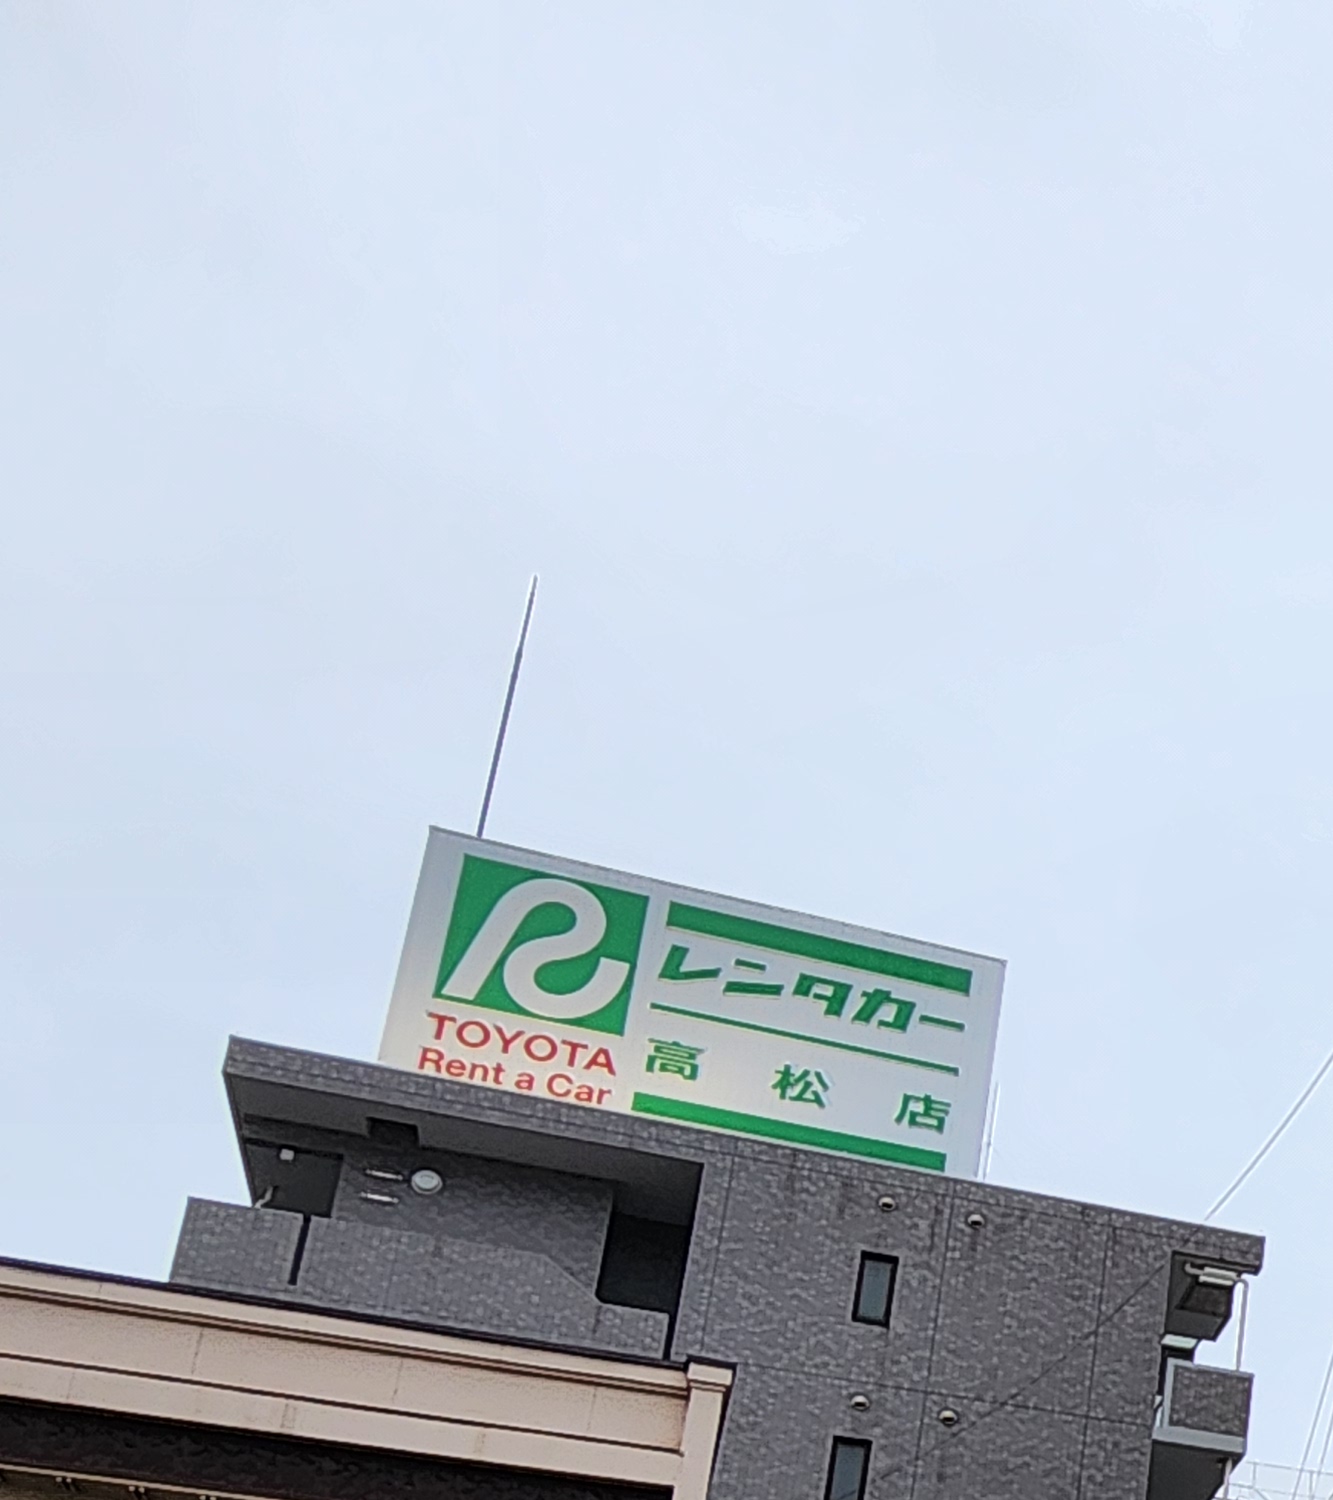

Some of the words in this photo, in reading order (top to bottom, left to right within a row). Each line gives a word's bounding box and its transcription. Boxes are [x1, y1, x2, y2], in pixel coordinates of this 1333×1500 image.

[658, 944, 966, 1033] レンタカー
[418, 1046, 505, 1085] Rent
[514, 1071, 535, 1091] a
[546, 1073, 612, 1105] Car
[426, 1010, 616, 1077] TOYOTA
[647, 1038, 951, 1134] 高松店
